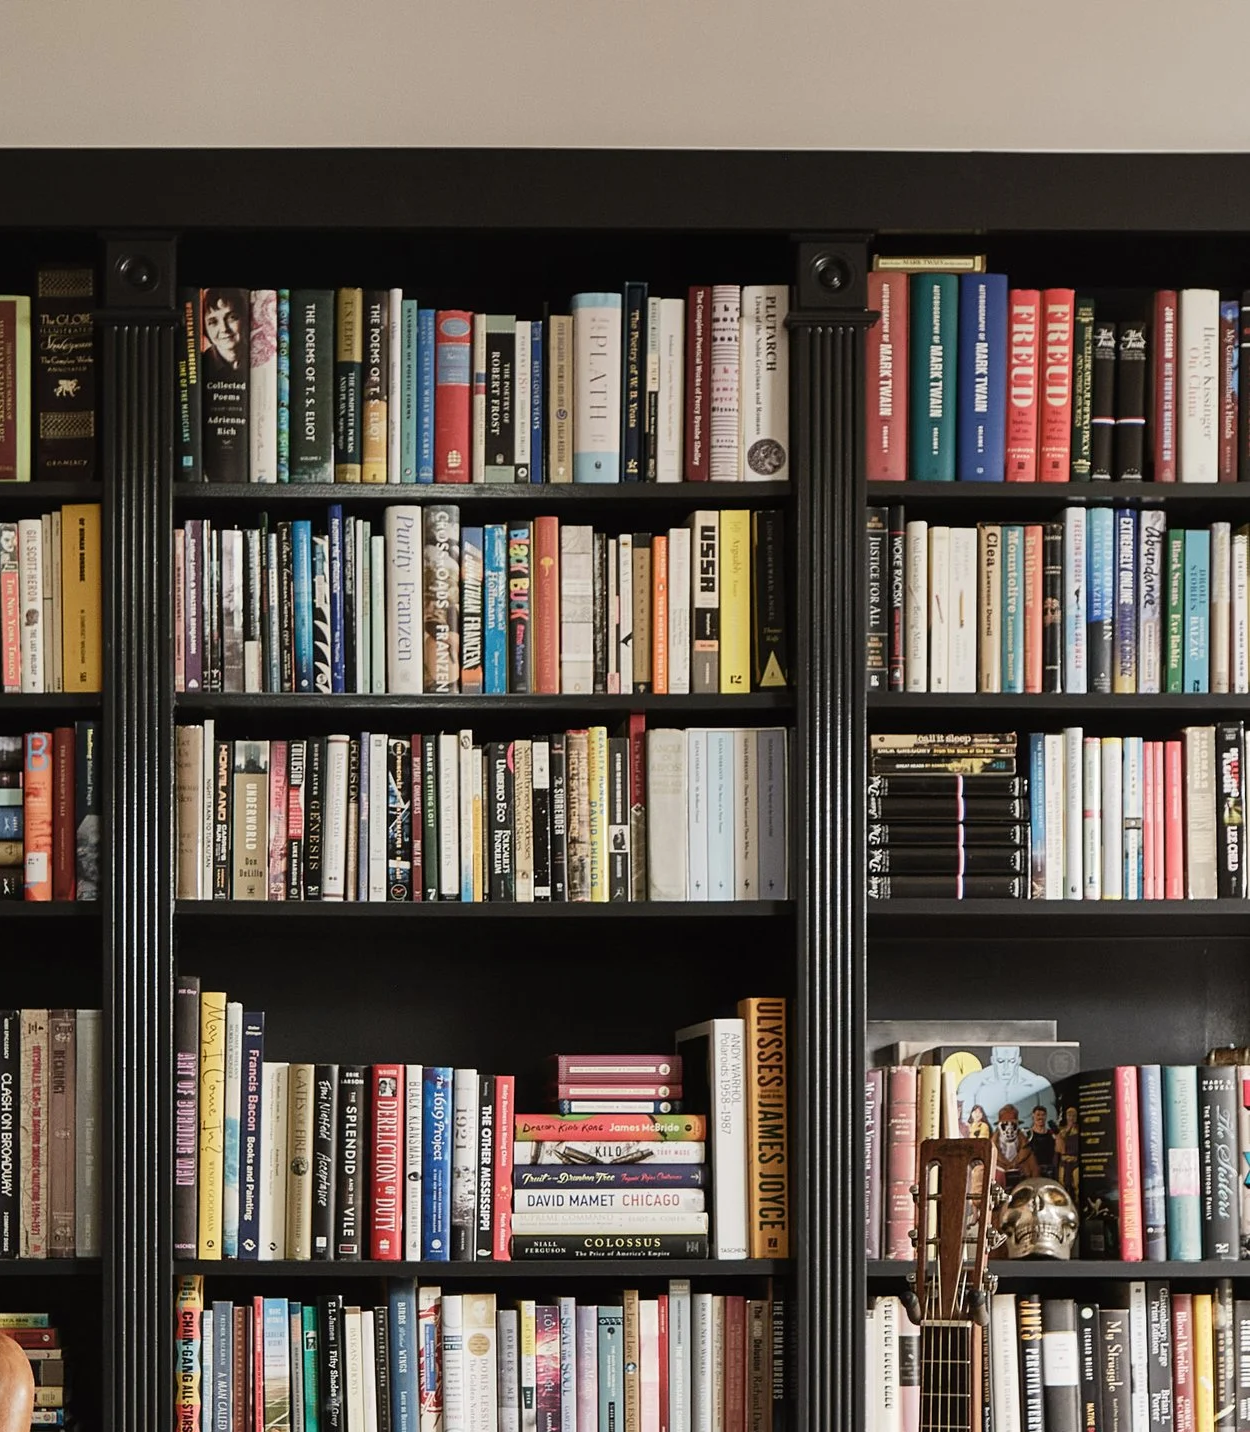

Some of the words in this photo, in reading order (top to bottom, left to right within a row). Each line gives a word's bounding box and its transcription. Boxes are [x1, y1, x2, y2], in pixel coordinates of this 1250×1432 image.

[305, 304, 315, 324] THE
[305, 328, 315, 365] POEMS
[766, 296, 777, 371] PLUTARCH
[880, 344, 893, 376] MARK
[975, 343, 988, 374] MARK
[1011, 303, 1035, 407] FREUD
[305, 369, 315, 382] OF
[305, 388, 315, 396] T.
[589, 335, 605, 420] PLATH
[305, 400, 315, 409] S.
[880, 379, 892, 416] TWAIN
[975, 377, 988, 411] TWAIN
[305, 412, 316, 441] ELIOT
[393, 515, 414, 572] Purity
[868, 536, 881, 580] JUSTICE
[893, 537, 902, 566] WOKE
[986, 532, 998, 566] Clea
[1121, 518, 1133, 568] EXTREMELY
[893, 569, 902, 607] RACISM
[1006, 530, 1019, 613] Mountolive
[1121, 571, 1133, 604] ONLINE
[869, 582, 880, 603] FOR
[397, 581, 414, 661] Franzen
[869, 605, 881, 627] ALL
[291, 744, 303, 784] COLLUSION
[245, 783, 259, 850] UNDERWORLD
[309, 801, 319, 870] GENESIS
[729, 1033, 740, 1056] ANDY
[757, 1002, 783, 1087] ULYSSES
[246, 1050, 259, 1090] Francis
[730, 1060, 740, 1106] WARHOL
[0, 1073, 12, 1109] CLASH
[409, 1081, 421, 1108] BLACK
[433, 1092, 447, 1119] 1619
[1, 1112, 11, 1130] ON
[247, 1095, 259, 1131] Bacon
[1216, 1106, 1232, 1136] The
[377, 1100, 397, 1181] DERELICTION
[408, 1112, 420, 1166] KLANSMAN
[431, 1123, 445, 1160] Project
[596, 1146, 621, 1156] KILO
[759, 1102, 783, 1165] JAMES
[0, 1133, 11, 1196] BROADWAY
[1217, 1146, 1235, 1218] Sisters
[383, 1186, 395, 1195] OF
[527, 1195, 564, 1206] DAVID
[569, 1195, 614, 1206] MAMET
[622, 1194, 679, 1206] CHICAGO
[761, 1173, 785, 1231] JOYCE
[376, 1199, 395, 1231] DUTY
[584, 1238, 661, 1247] COLOSSUS
[1021, 1301, 1041, 1340] JAMES
[1105, 1321, 1122, 1341] My
[181, 1312, 195, 1381] CHAIN-GANG
[327, 1351, 337, 1368] Fifty
[329, 1371, 338, 1396] Shades
[1027, 1349, 1041, 1394] PERCIVAL
[1107, 1345, 1122, 1392] Struggle
[217, 1381, 227, 1399] MAN
[330, 1398, 339, 1406] of
[181, 1385, 195, 1432] ALL-STARS
[217, 1402, 227, 1430] CALLED
[328, 1408, 339, 1426] Grey
